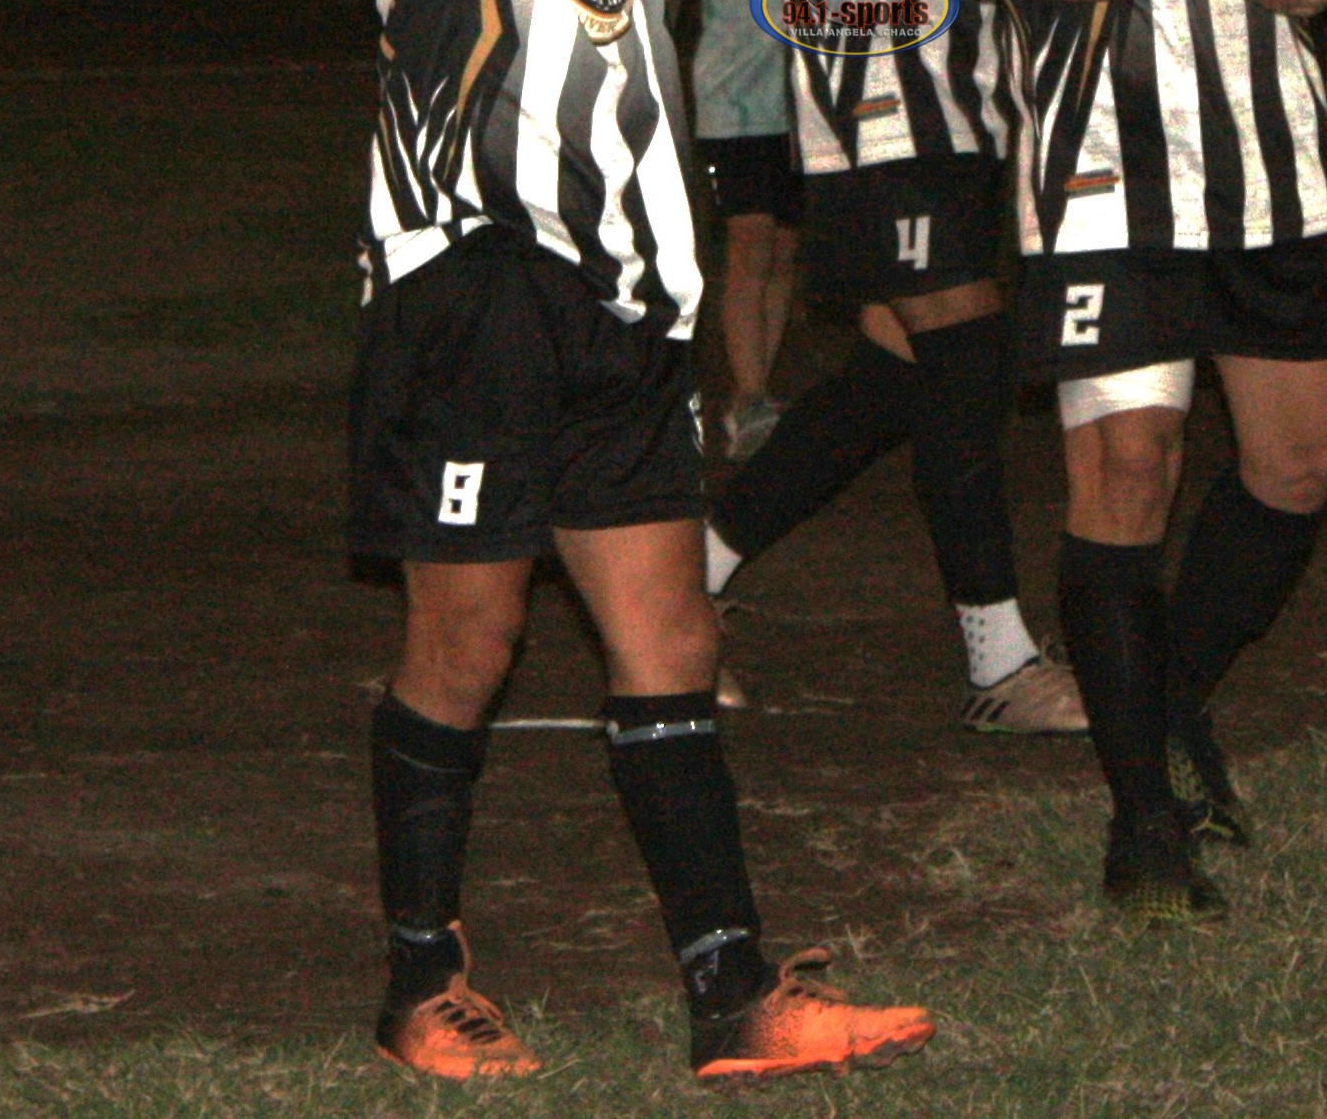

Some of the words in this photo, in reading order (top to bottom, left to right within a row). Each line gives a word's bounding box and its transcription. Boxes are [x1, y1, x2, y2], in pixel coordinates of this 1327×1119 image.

[895, 215, 931, 270] 4
[1061, 283, 1105, 346] 2
[437, 461, 485, 526] 8
